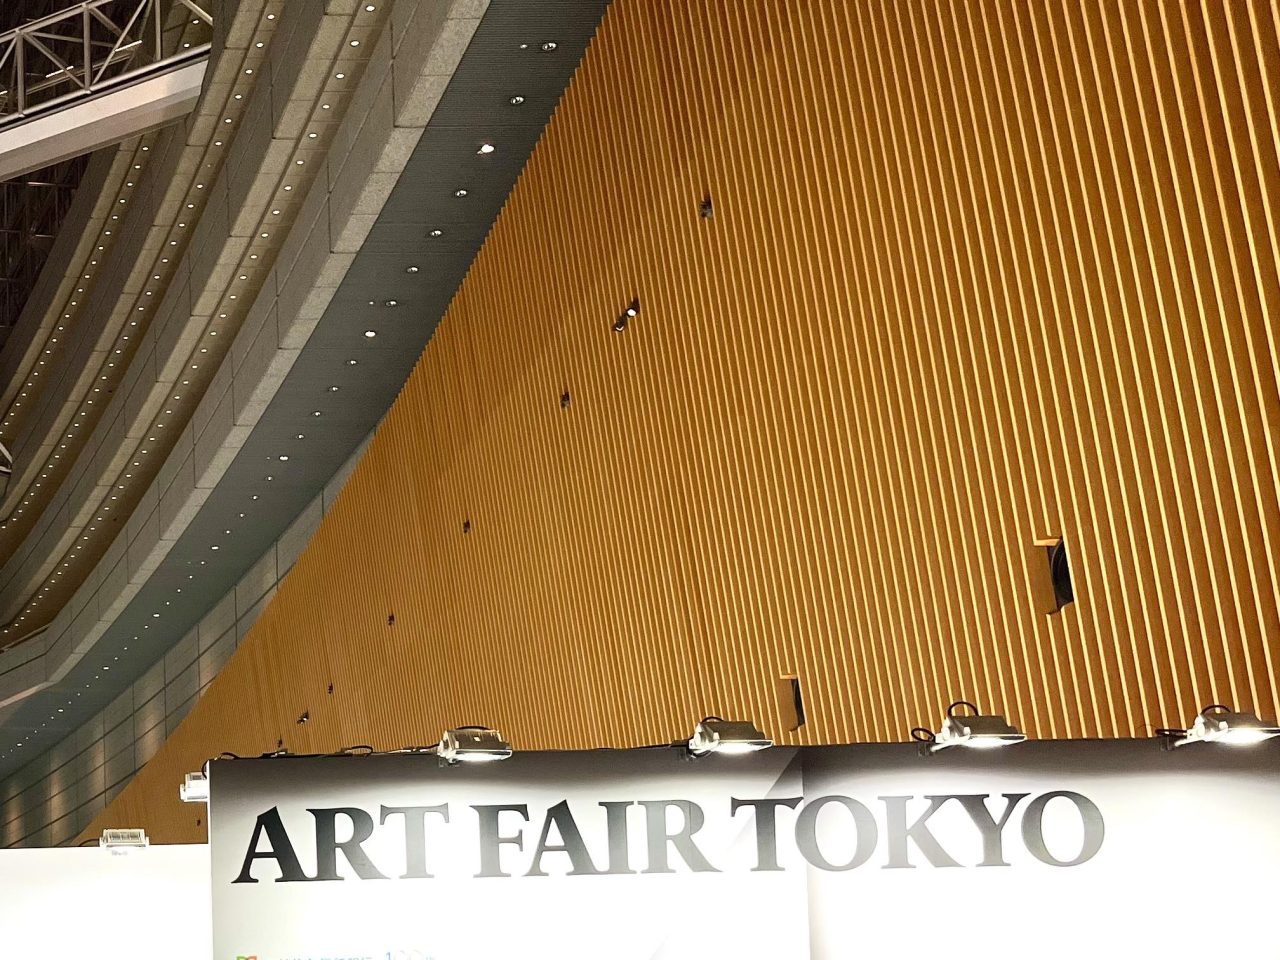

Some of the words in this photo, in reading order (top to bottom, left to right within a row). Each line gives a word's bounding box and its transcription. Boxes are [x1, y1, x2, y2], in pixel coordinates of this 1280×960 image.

[231, 802, 449, 884] ART
[469, 798, 723, 879] FAIR
[731, 790, 1106, 872] TOKYO
